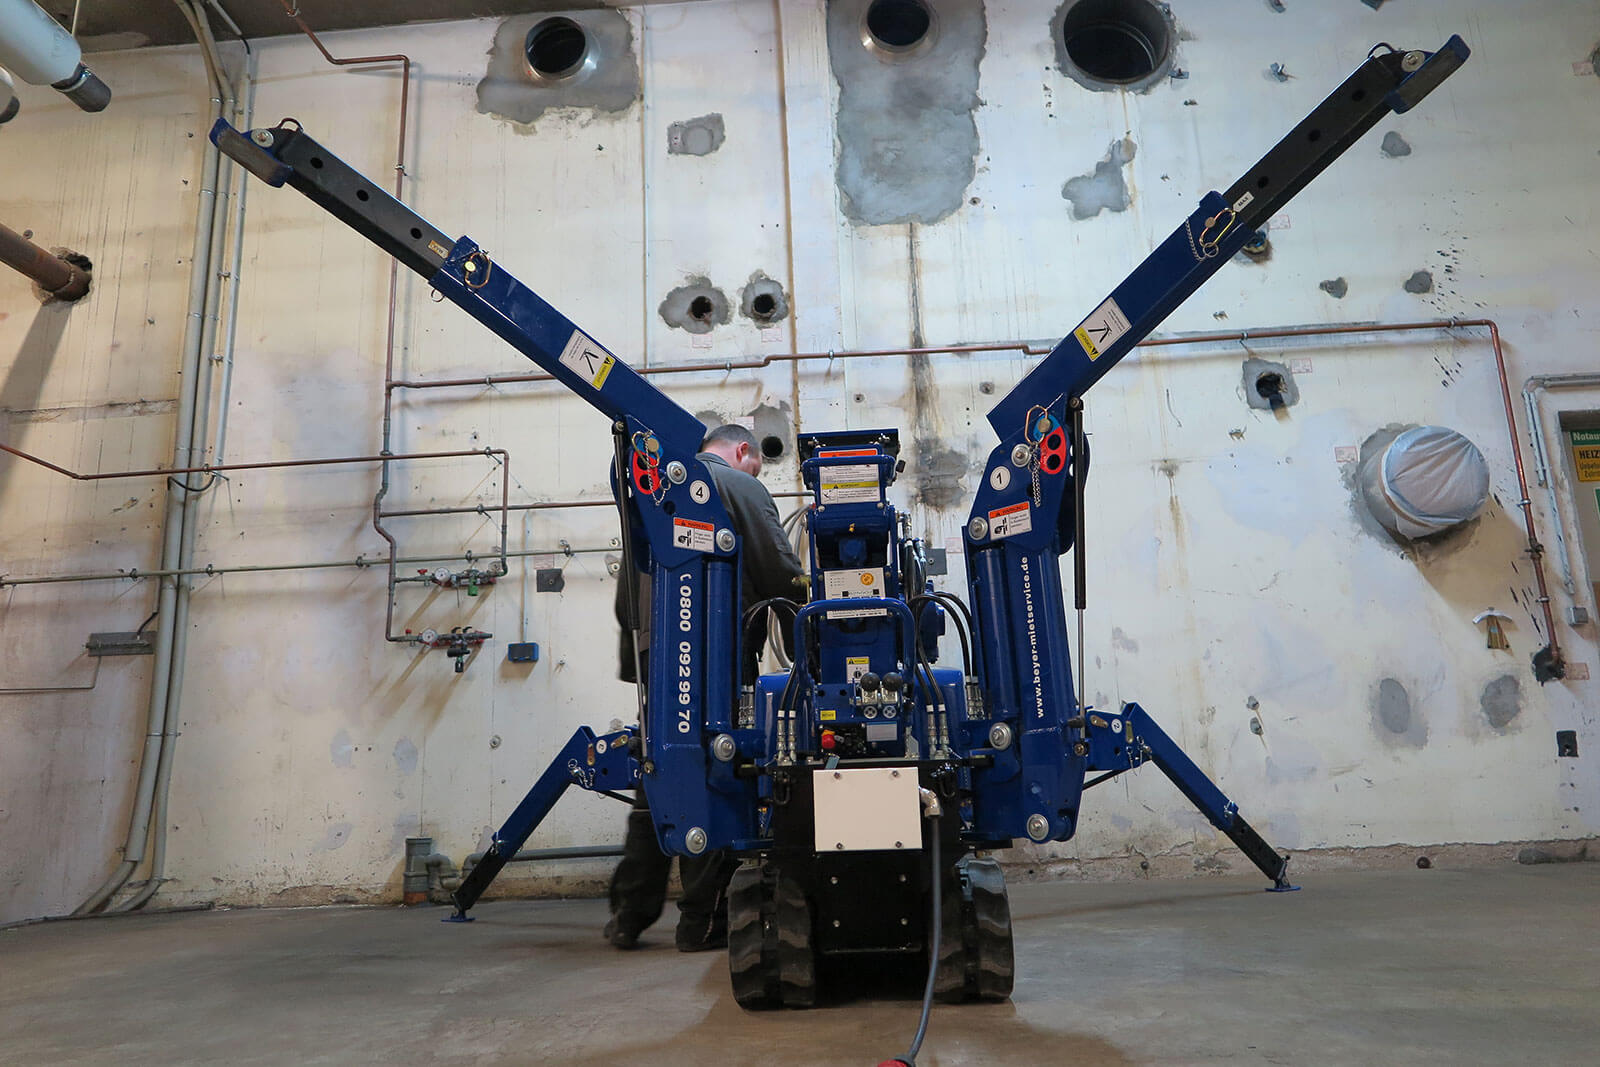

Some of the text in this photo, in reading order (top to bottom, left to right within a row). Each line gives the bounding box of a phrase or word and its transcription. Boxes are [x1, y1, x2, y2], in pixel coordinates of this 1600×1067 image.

[695, 486, 704, 499] 4
[996, 472, 1002, 485] 1
[679, 585, 692, 632] 0800
[1021, 556, 1045, 719] www.beyer-mietservice.de
